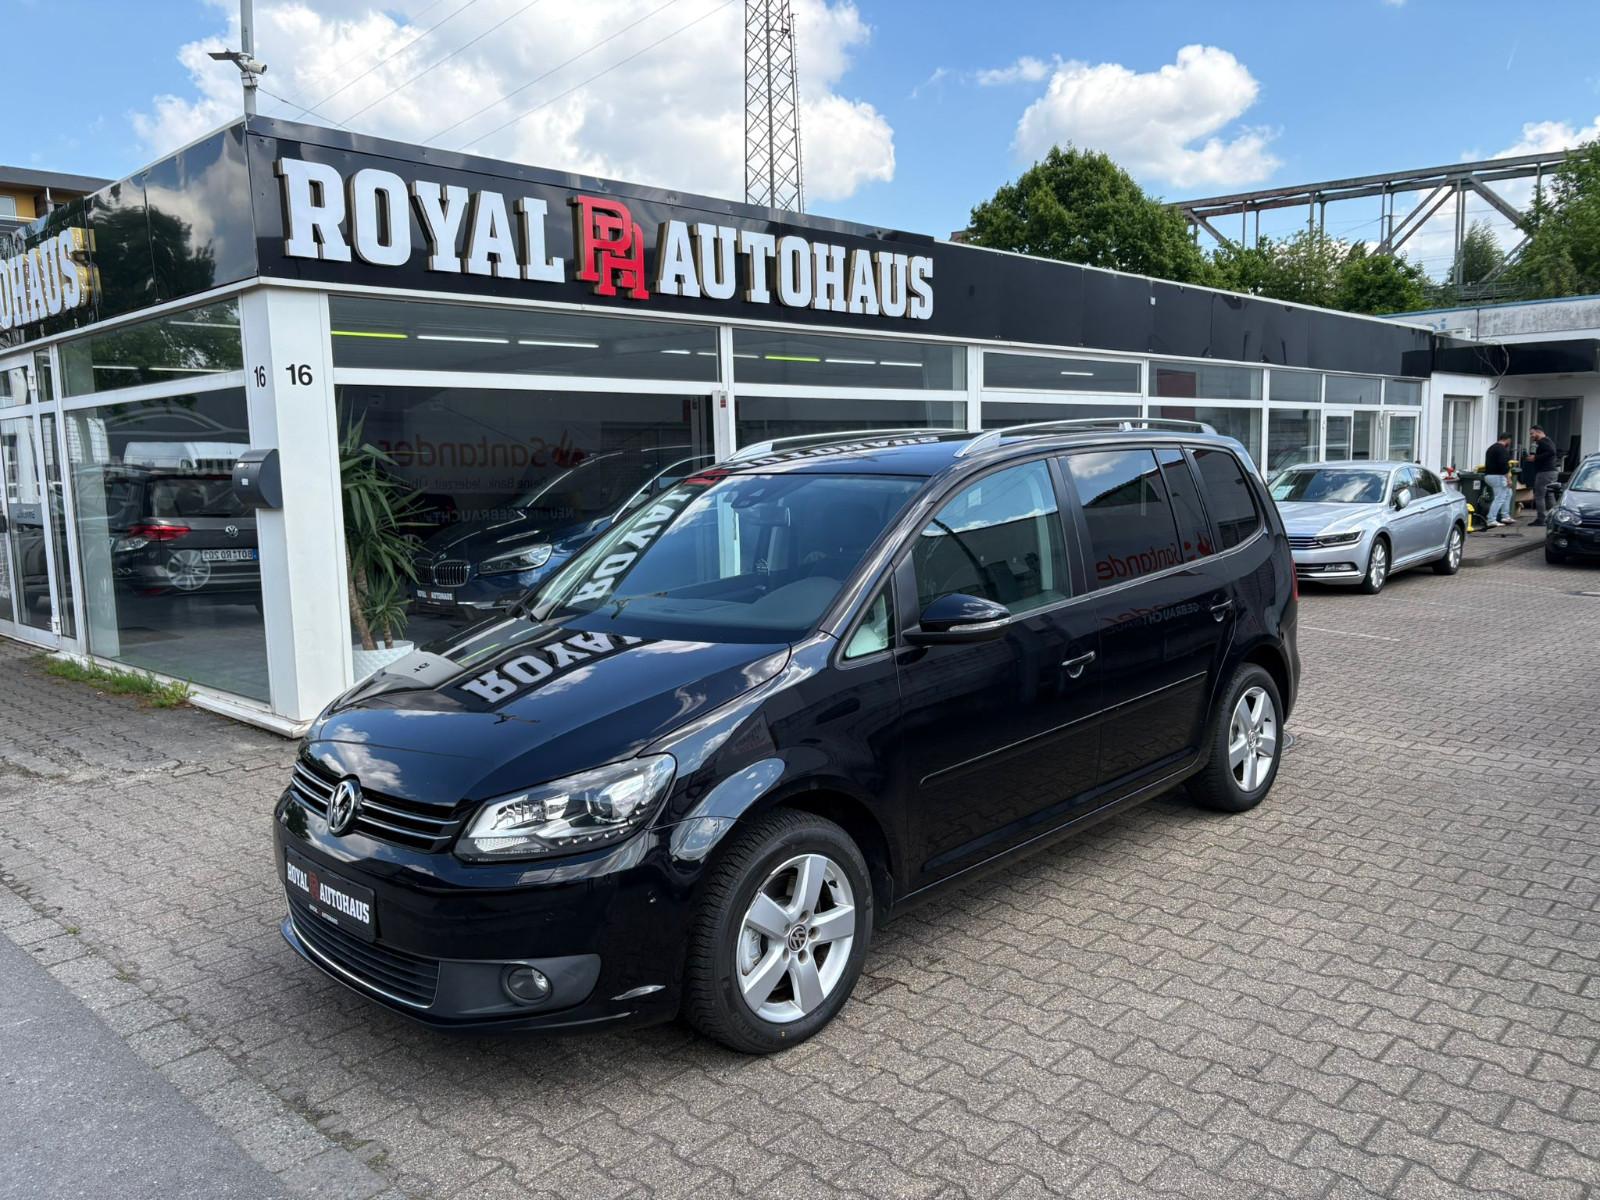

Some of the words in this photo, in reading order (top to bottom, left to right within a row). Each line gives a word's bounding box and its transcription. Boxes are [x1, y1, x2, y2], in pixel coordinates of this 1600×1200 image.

[277, 157, 566, 283] ROYAL
[657, 220, 934, 320] AUTOHAUS
[254, 365, 267, 388] 16
[286, 363, 314, 386] 16
[287, 862, 309, 893] ROYAL
[320, 883, 370, 924] AUTOHAUS
